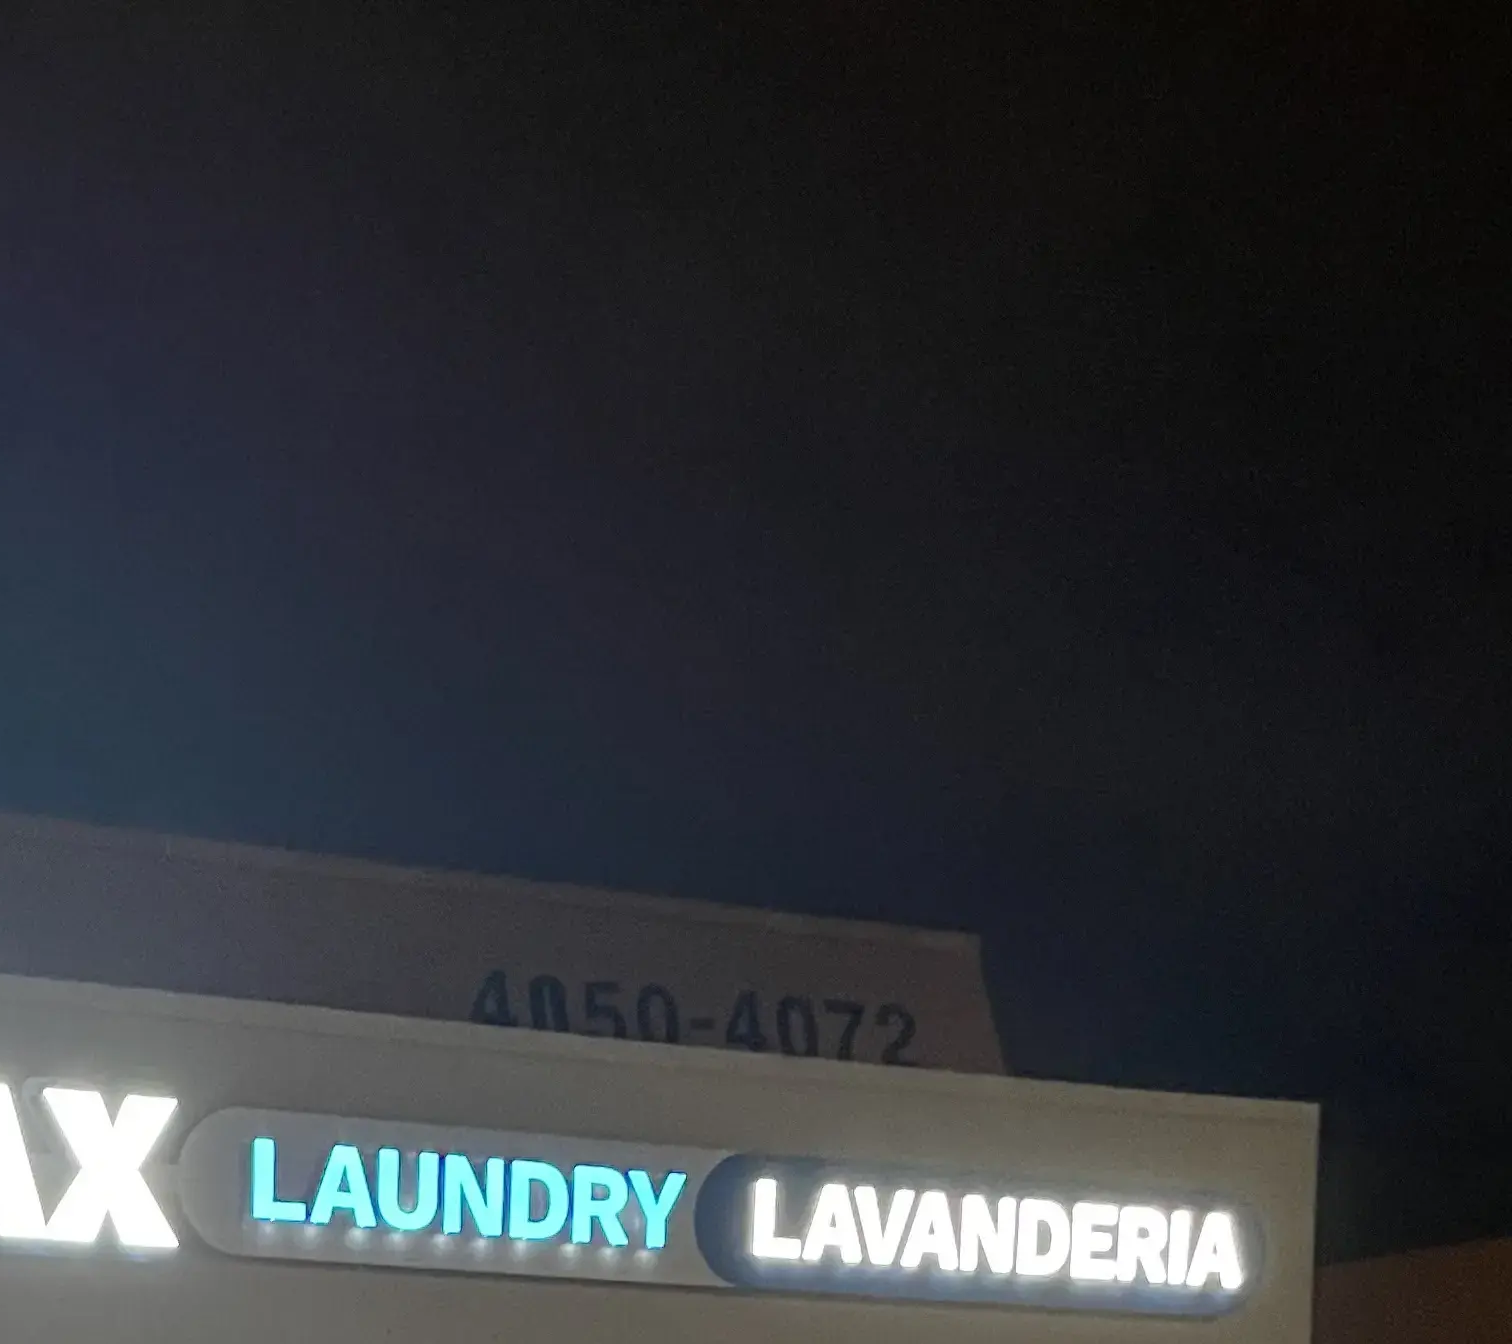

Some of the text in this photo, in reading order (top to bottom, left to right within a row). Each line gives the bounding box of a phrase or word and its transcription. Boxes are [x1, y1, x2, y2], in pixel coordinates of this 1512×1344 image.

[469, 969, 917, 1066] 4050-4072
[249, 1137, 1244, 1290] LAUNDRY LAVANDERIA
